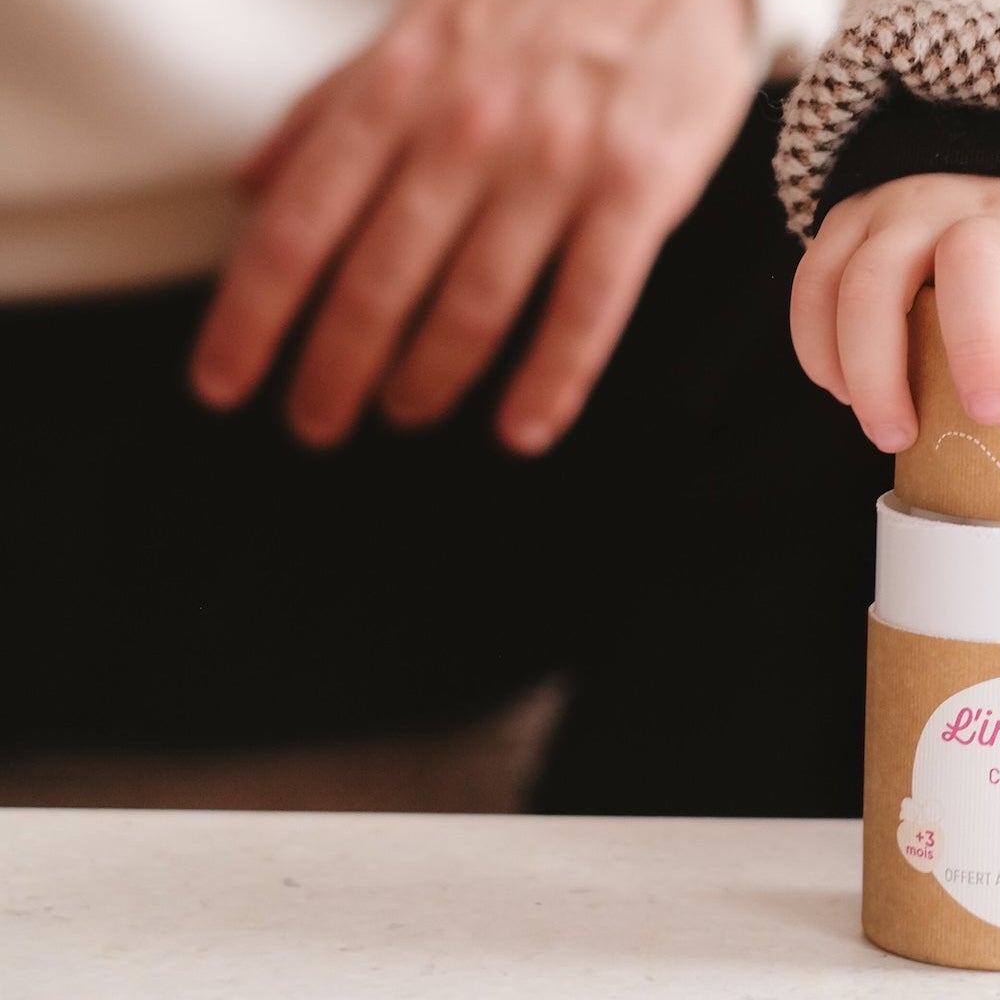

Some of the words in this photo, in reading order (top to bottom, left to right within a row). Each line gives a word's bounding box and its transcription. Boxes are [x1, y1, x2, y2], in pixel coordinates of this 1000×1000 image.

[916, 830, 935, 848] +3
[906, 845, 934, 860] mois
[944, 868, 990, 886] OFFERT
